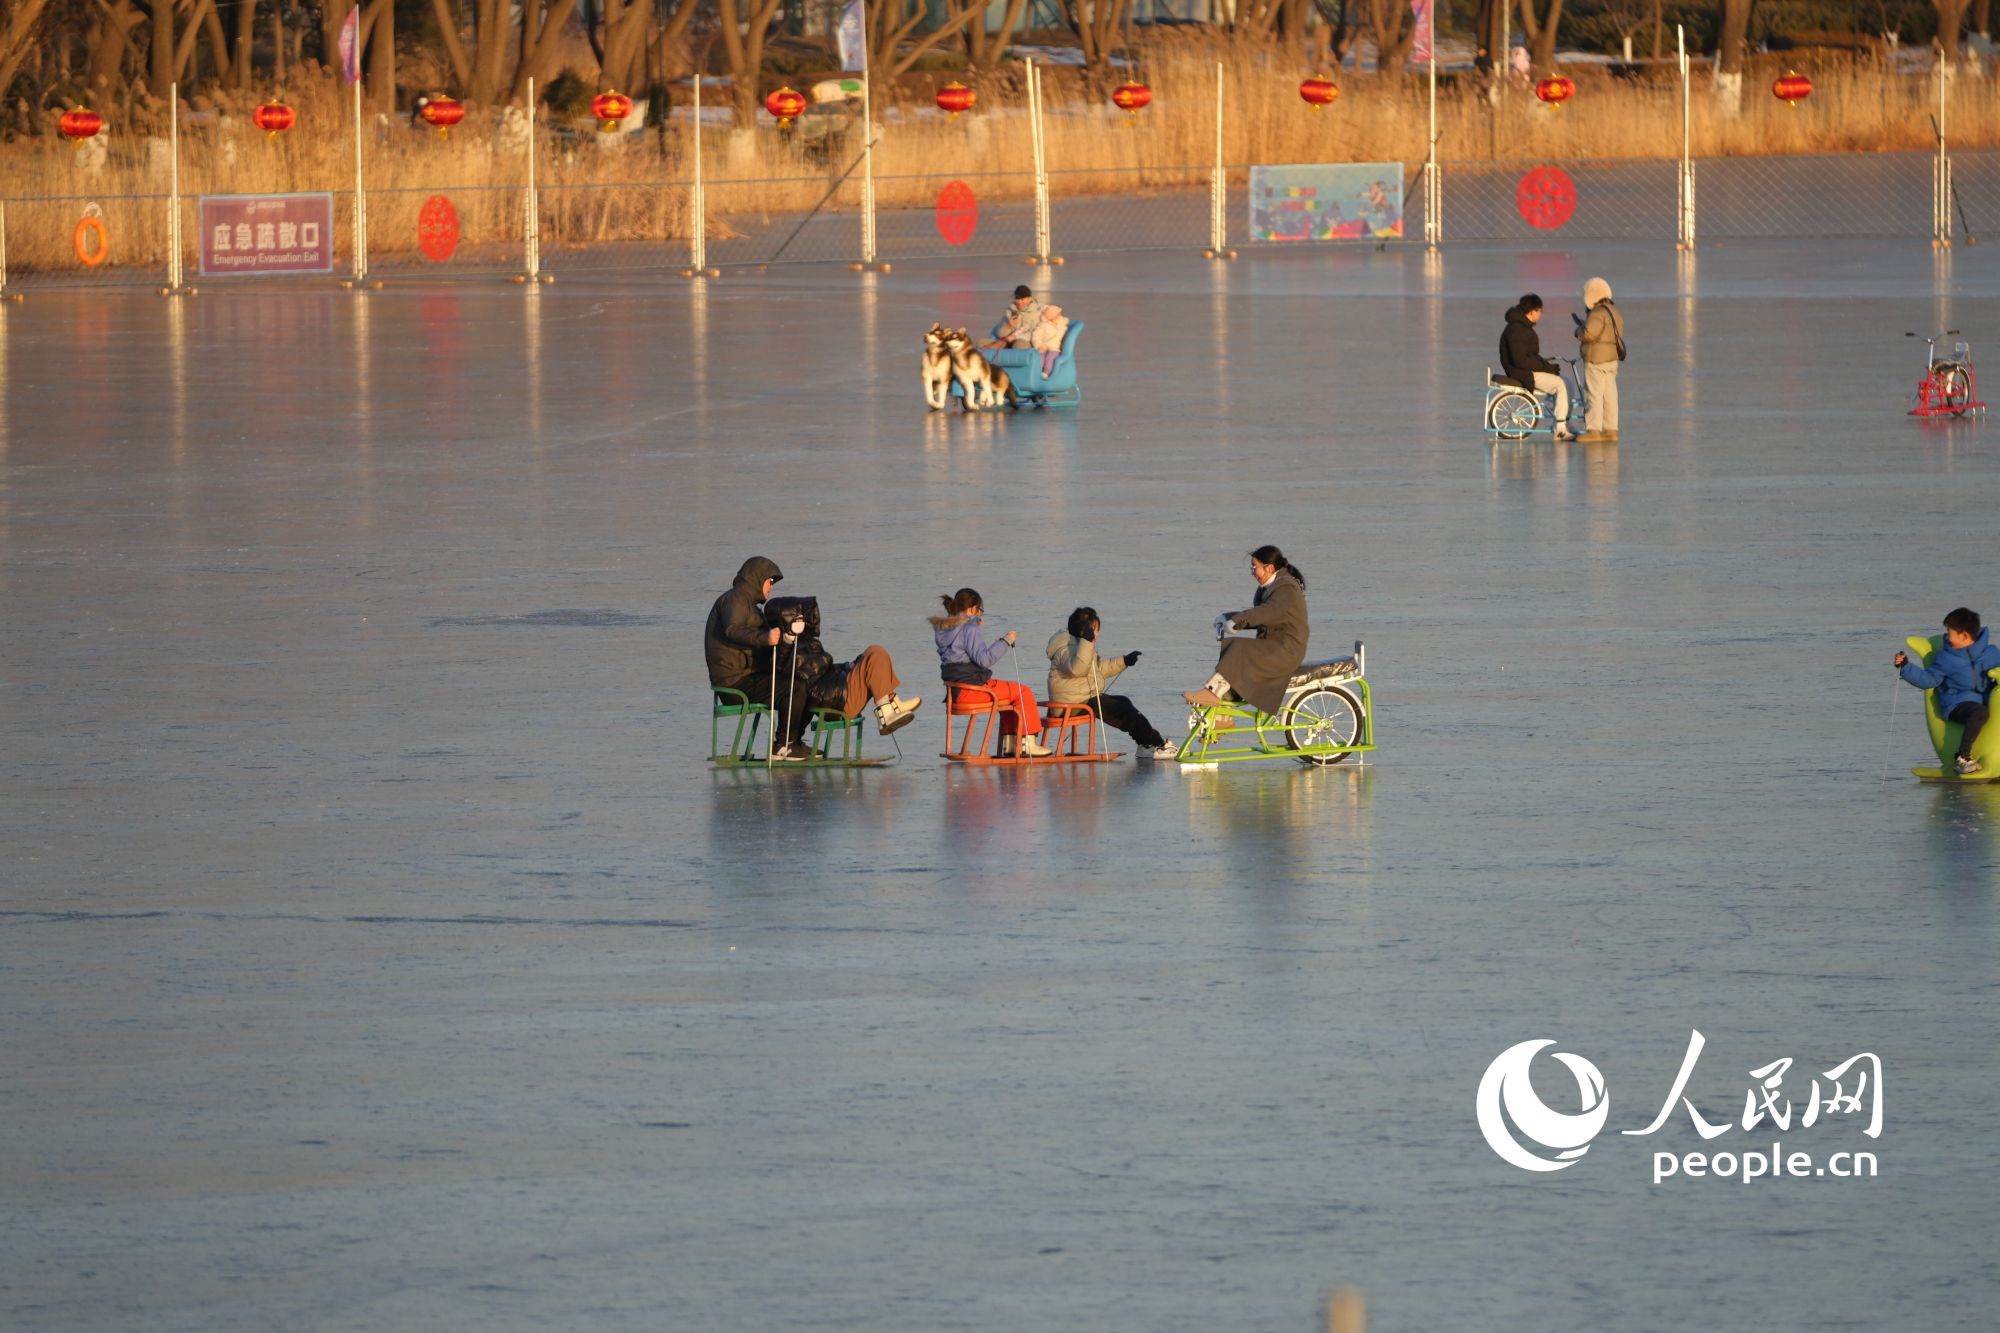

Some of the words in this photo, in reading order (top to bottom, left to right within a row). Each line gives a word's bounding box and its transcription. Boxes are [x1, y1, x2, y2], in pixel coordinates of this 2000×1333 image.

[213, 222, 320, 251] 应急疏散口
[213, 254, 257, 266] Emergency
[258, 252, 302, 264] Evacuation
[303, 251, 320, 262] Exit
